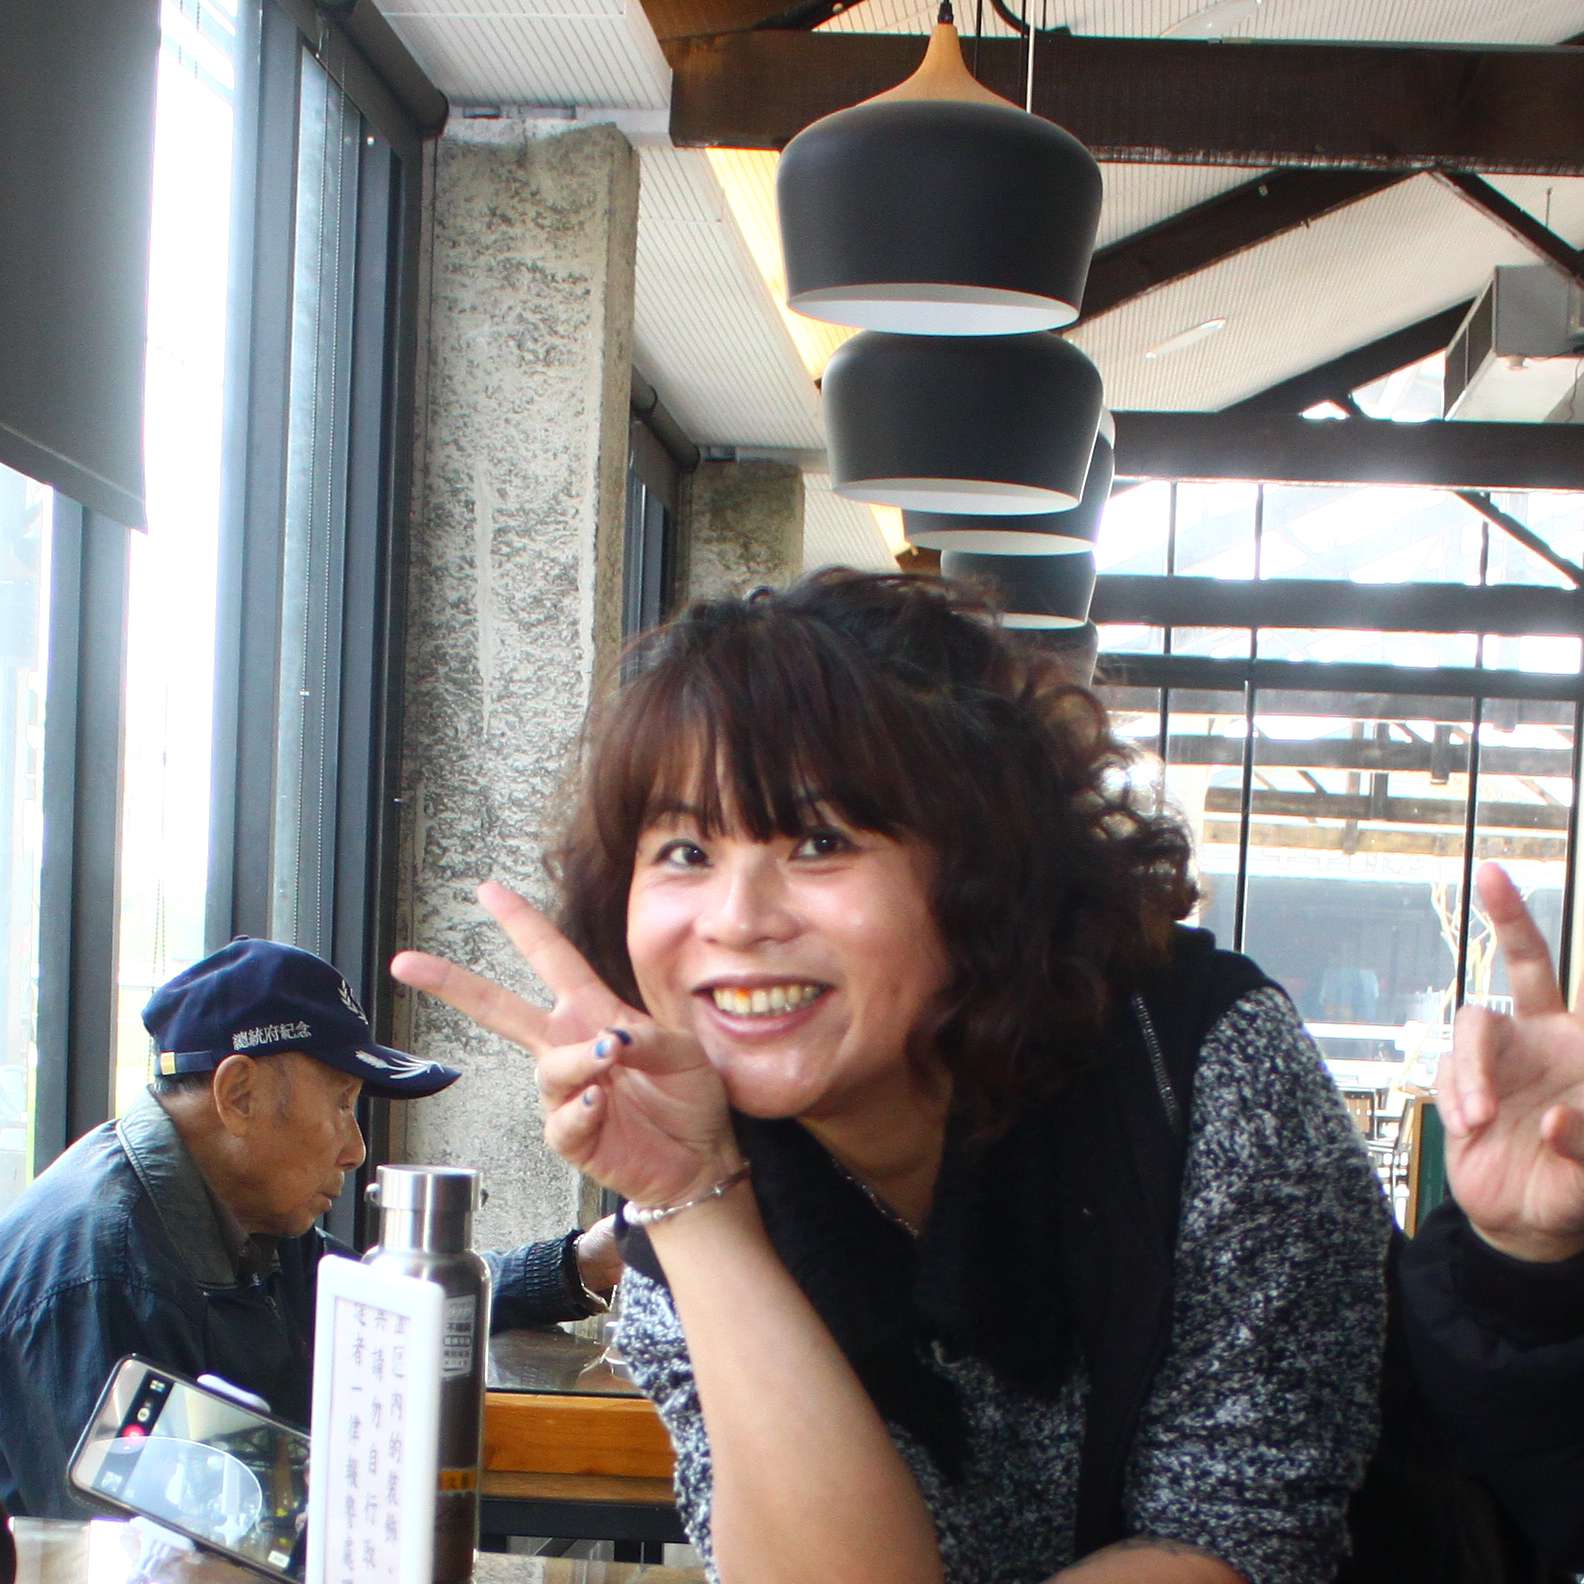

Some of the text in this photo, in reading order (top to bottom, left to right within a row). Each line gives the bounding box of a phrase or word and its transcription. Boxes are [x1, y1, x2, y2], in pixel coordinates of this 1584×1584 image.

[232, 1021, 312, 1051] 總統府紀念
